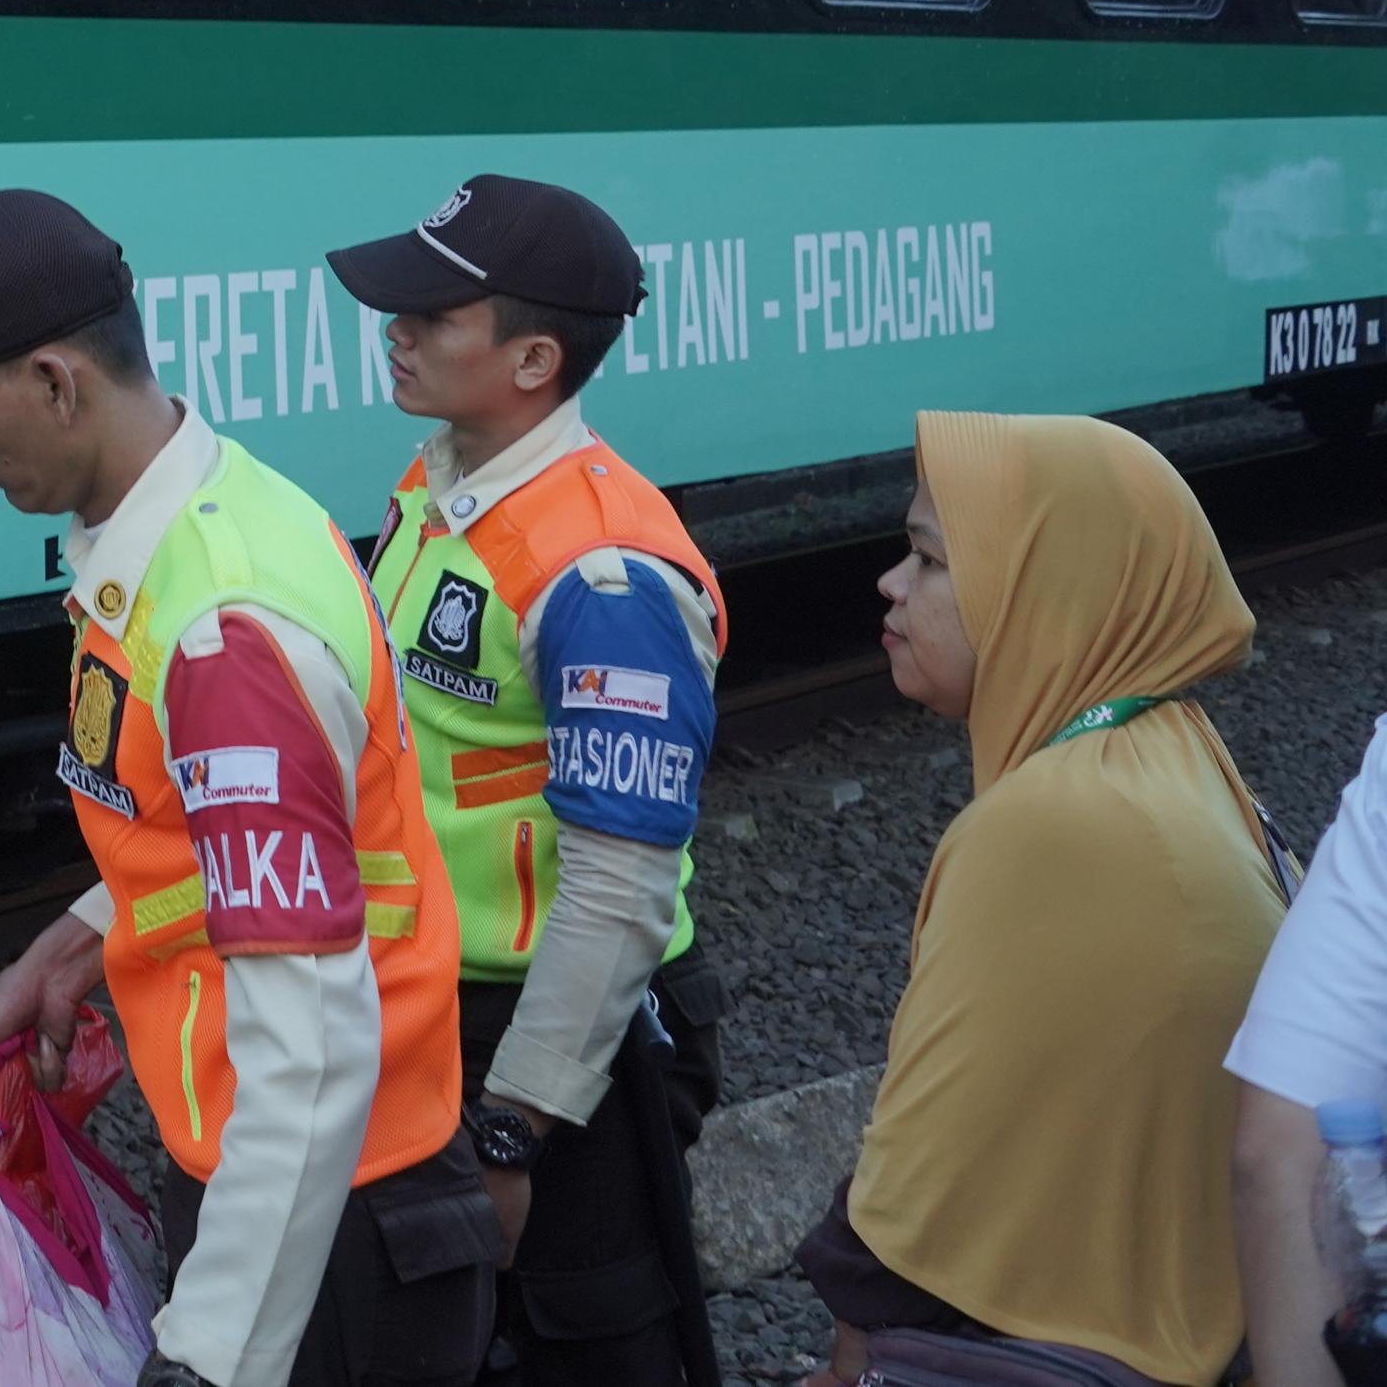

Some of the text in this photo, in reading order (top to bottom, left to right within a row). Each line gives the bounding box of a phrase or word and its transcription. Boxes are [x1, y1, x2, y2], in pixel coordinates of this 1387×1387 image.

[133, 266, 340, 423] ERETA
[794, 221, 995, 354] PEDAGANG
[410, 656, 488, 698] SATPAM
[568, 668, 608, 695] KAI
[595, 694, 662, 713] Commuter
[63, 754, 131, 813] SATPAM
[179, 756, 210, 792] KAI
[202, 784, 271, 801] Commuter
